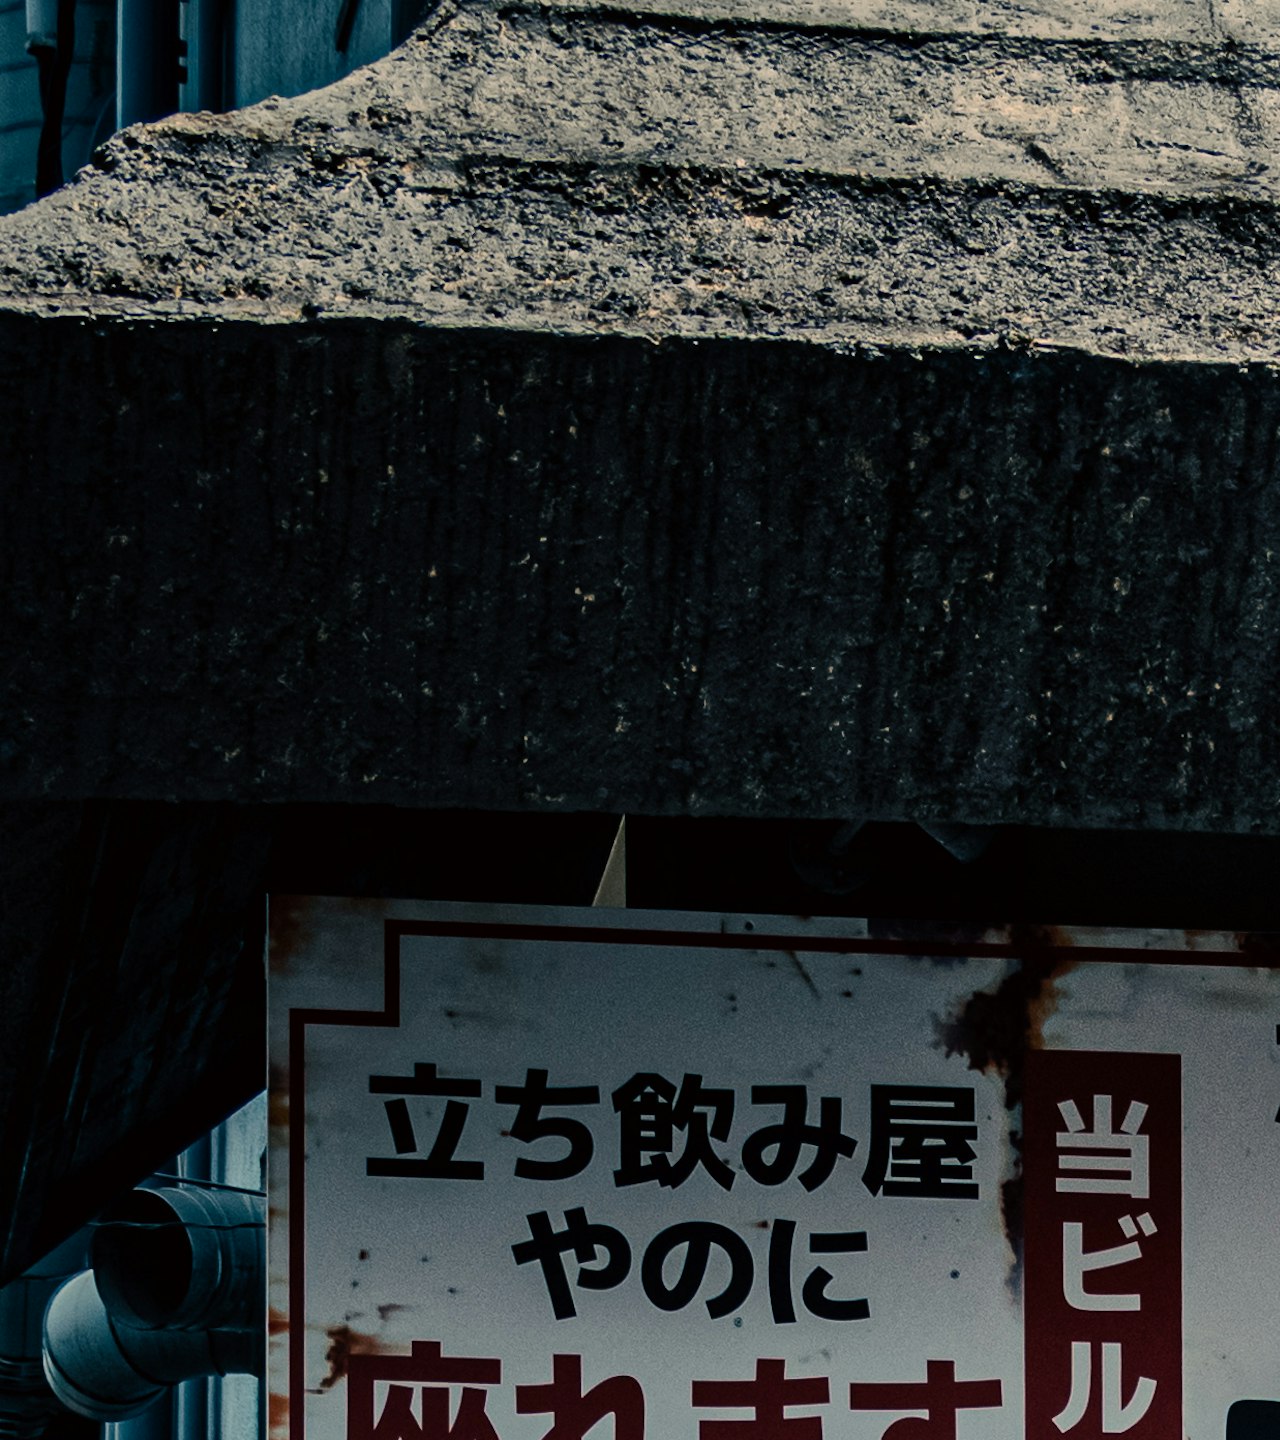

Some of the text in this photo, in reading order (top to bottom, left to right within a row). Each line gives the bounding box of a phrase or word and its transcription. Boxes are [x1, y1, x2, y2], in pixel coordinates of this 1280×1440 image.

[366, 1063, 980, 1199] 立ち飲み屋
[510, 1208, 870, 1323] やのに
